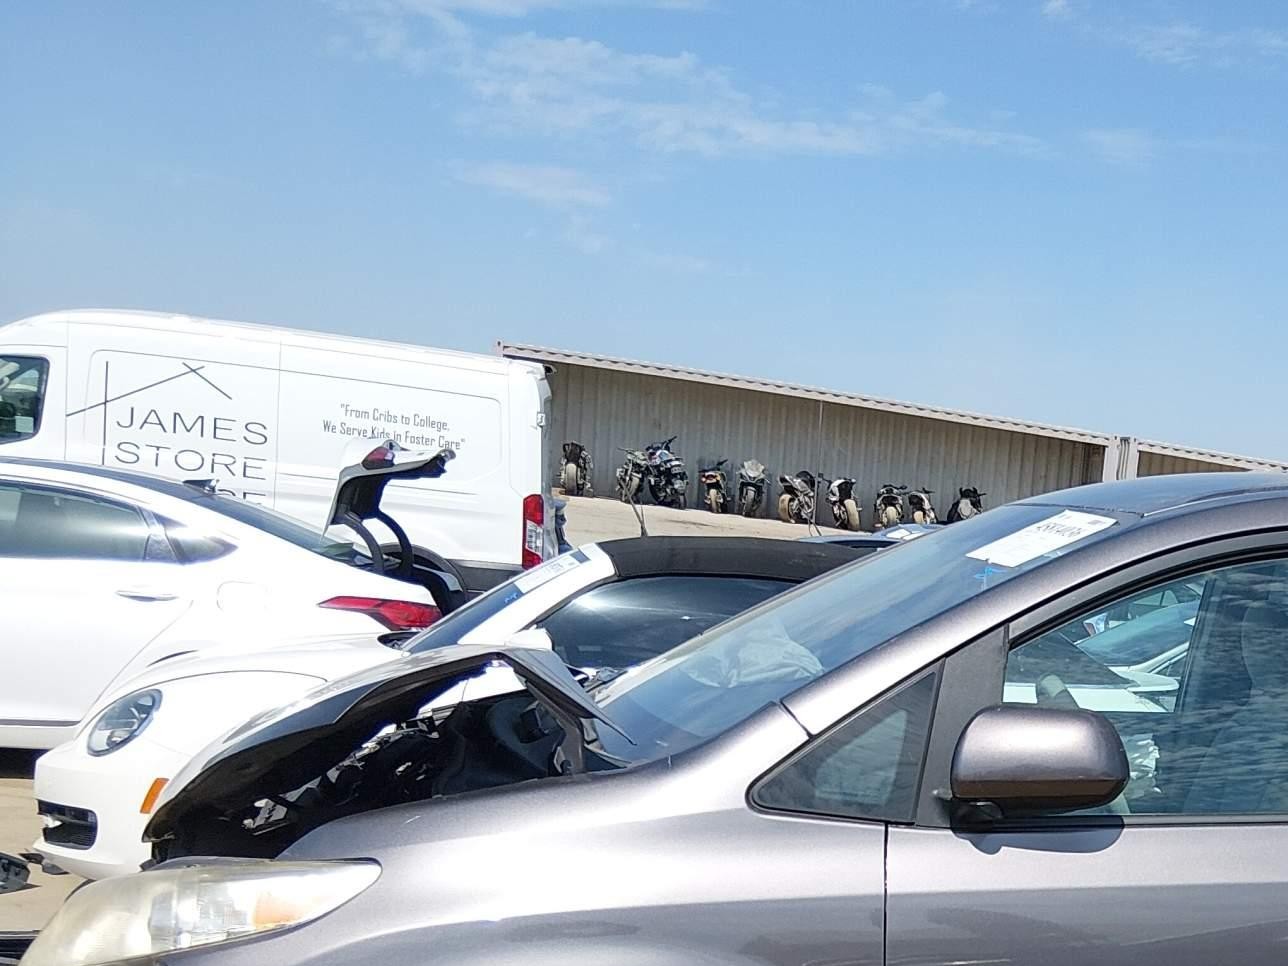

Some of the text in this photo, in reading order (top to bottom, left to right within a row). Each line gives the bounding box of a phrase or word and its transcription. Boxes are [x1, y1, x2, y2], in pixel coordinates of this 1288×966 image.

[116, 405, 269, 446] JAMES
[322, 419, 337, 434] We
[339, 422, 368, 438] Serve
[371, 425, 391, 439] Kids
[393, 430, 402, 443] in
[404, 430, 436, 447] Foster
[372, 407, 398, 424] Cribs
[401, 413, 411, 426] to
[413, 413, 450, 432] College,
[115, 441, 268, 481] STORE
